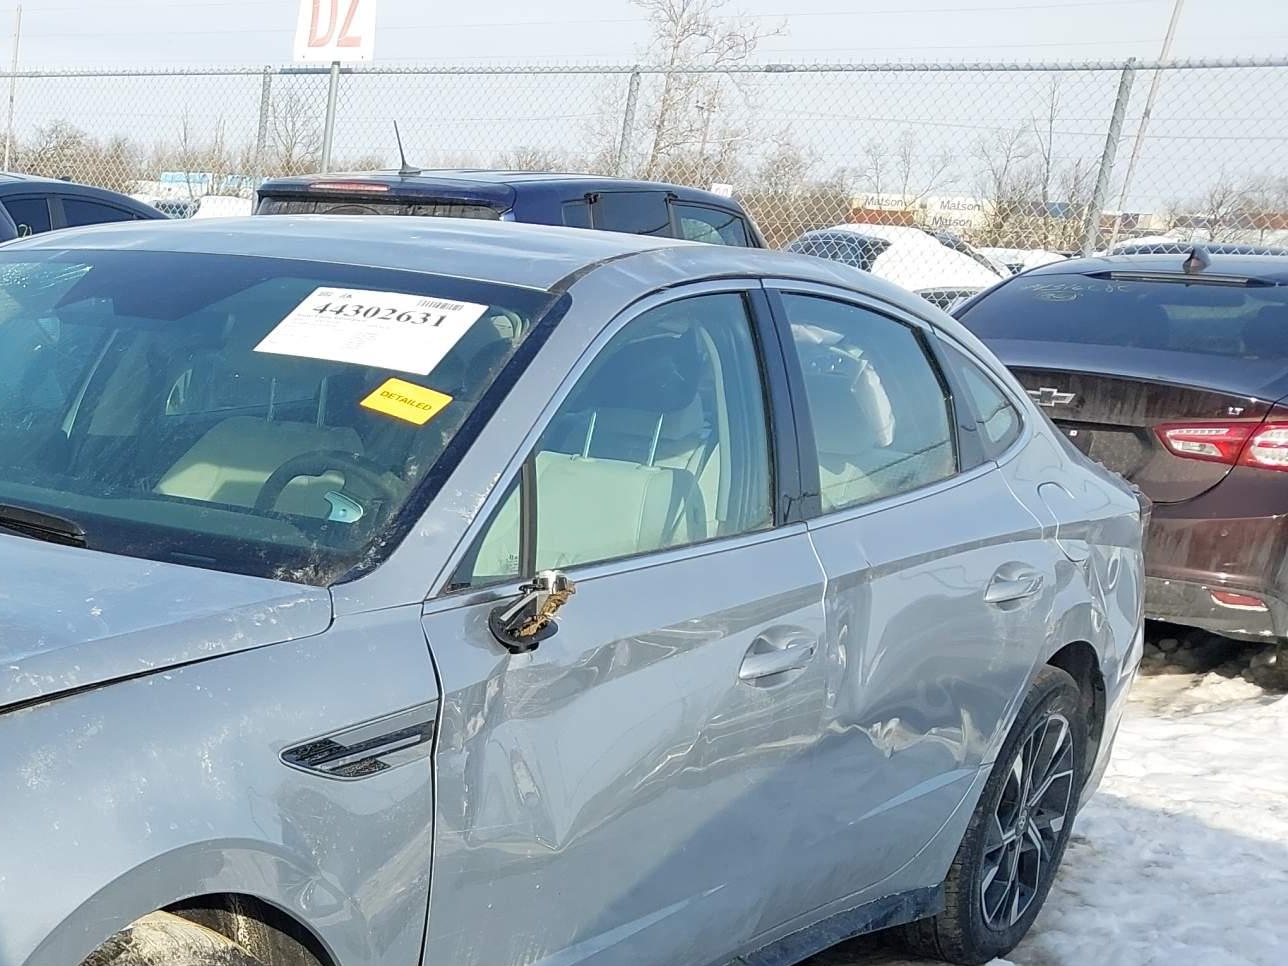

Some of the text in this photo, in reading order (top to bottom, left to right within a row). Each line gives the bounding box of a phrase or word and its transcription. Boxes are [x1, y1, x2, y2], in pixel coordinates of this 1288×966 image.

[865, 195, 904, 207] Matson
[940, 200, 981, 211] Matson
[931, 216, 972, 227] Matson
[312, 301, 448, 328] 44302631
[380, 390, 433, 412] DETAILED
